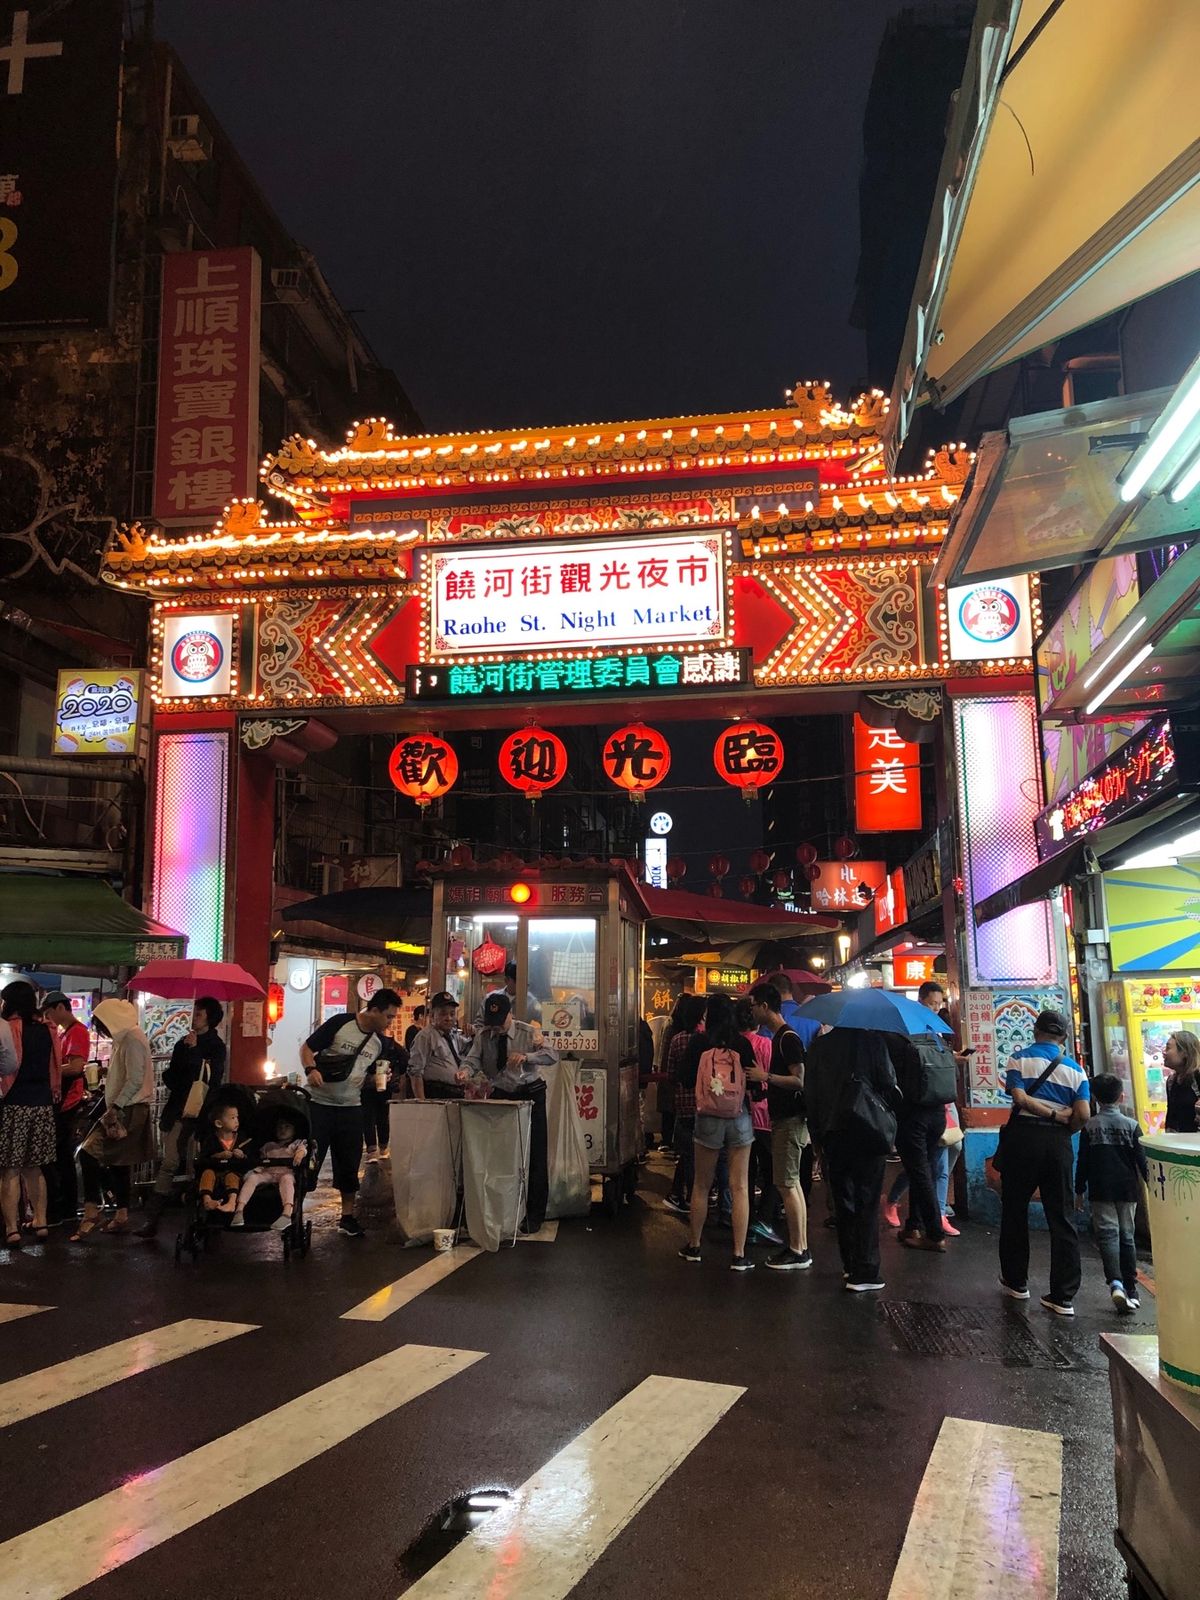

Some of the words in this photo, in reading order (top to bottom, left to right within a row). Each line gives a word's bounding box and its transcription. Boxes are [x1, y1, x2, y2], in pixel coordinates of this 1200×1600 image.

[167, 256, 240, 510] 上順珠寶銀樓
[444, 555, 709, 601] 饒河街觀光夜市
[444, 616, 506, 636] Raohe
[520, 614, 546, 632] St.
[561, 609, 616, 632] Night
[633, 604, 713, 625] Market
[60, 694, 132, 720] 2020
[551, 885, 604, 902] 服務台
[340, 1043, 373, 1060] ATTIUDE
